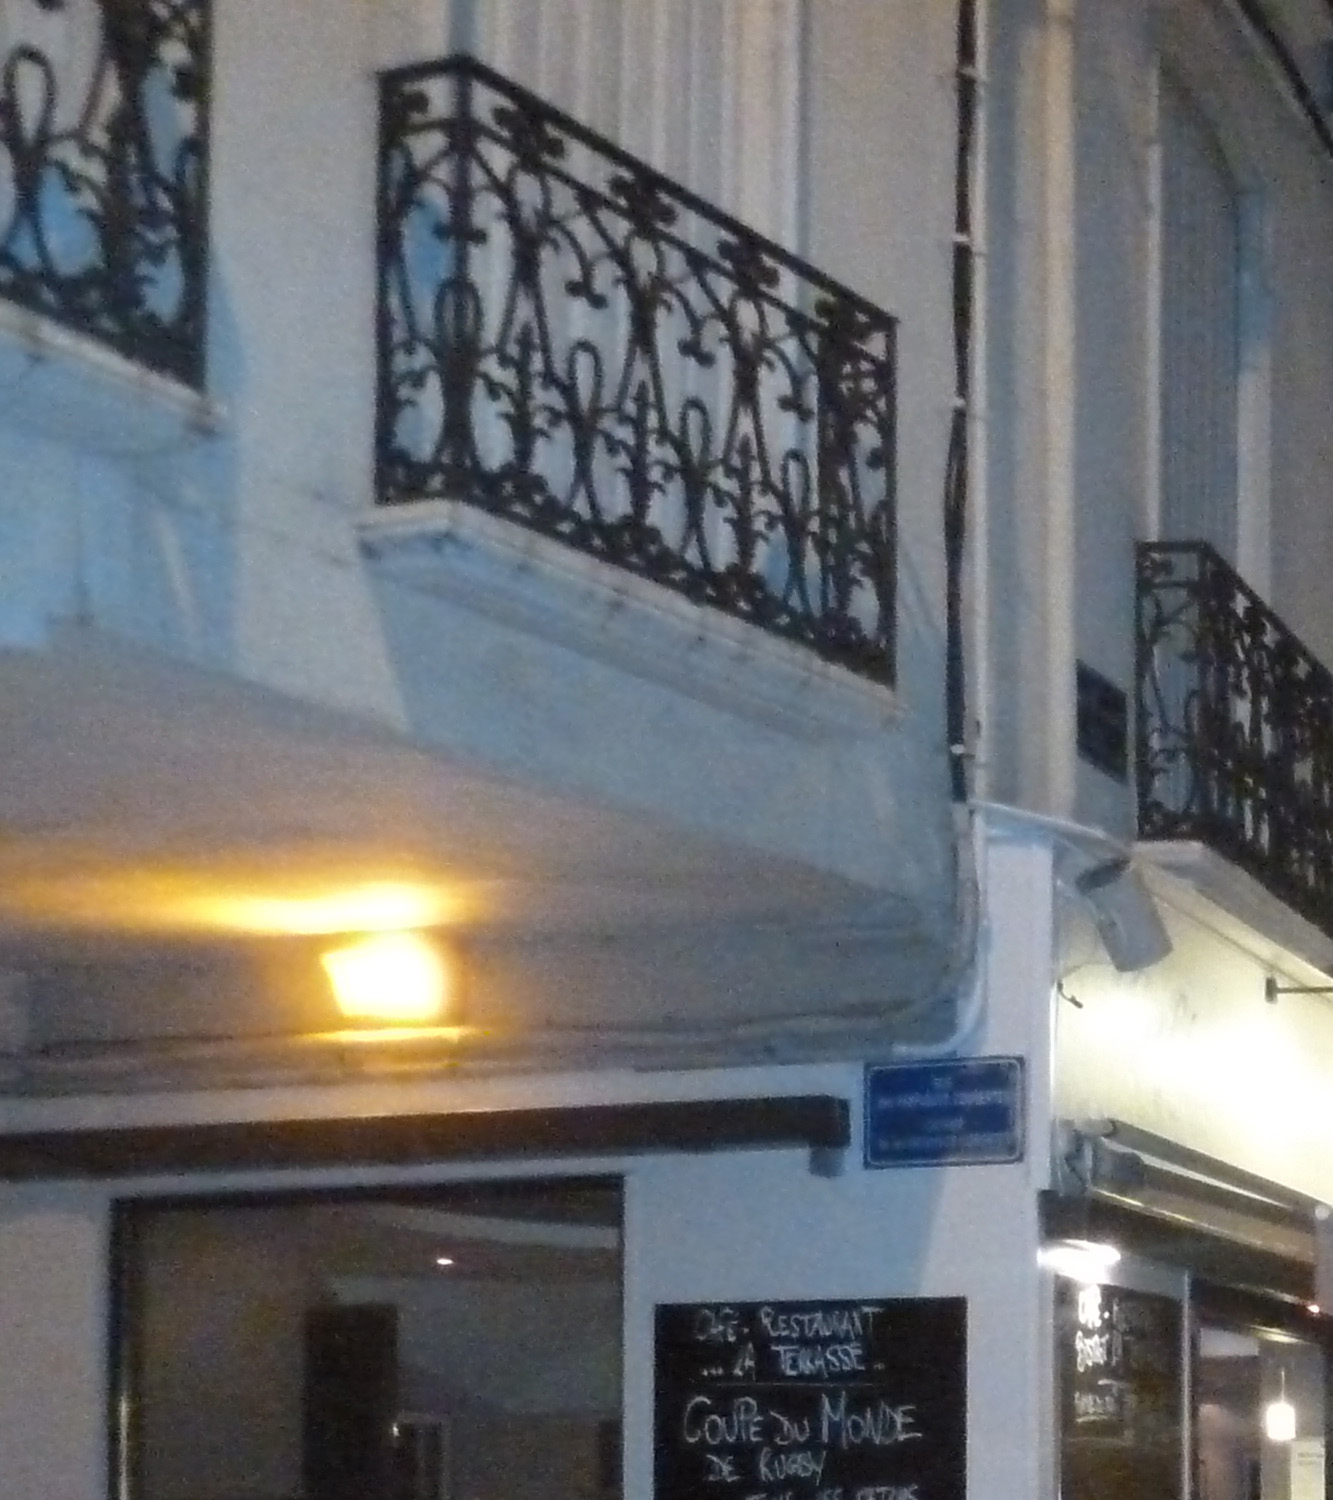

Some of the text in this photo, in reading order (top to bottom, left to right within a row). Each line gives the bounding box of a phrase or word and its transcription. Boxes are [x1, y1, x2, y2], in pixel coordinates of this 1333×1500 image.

[683, 1390, 923, 1450] COUPE DU MONDE
[705, 1446, 827, 1487] DE RUGBY
